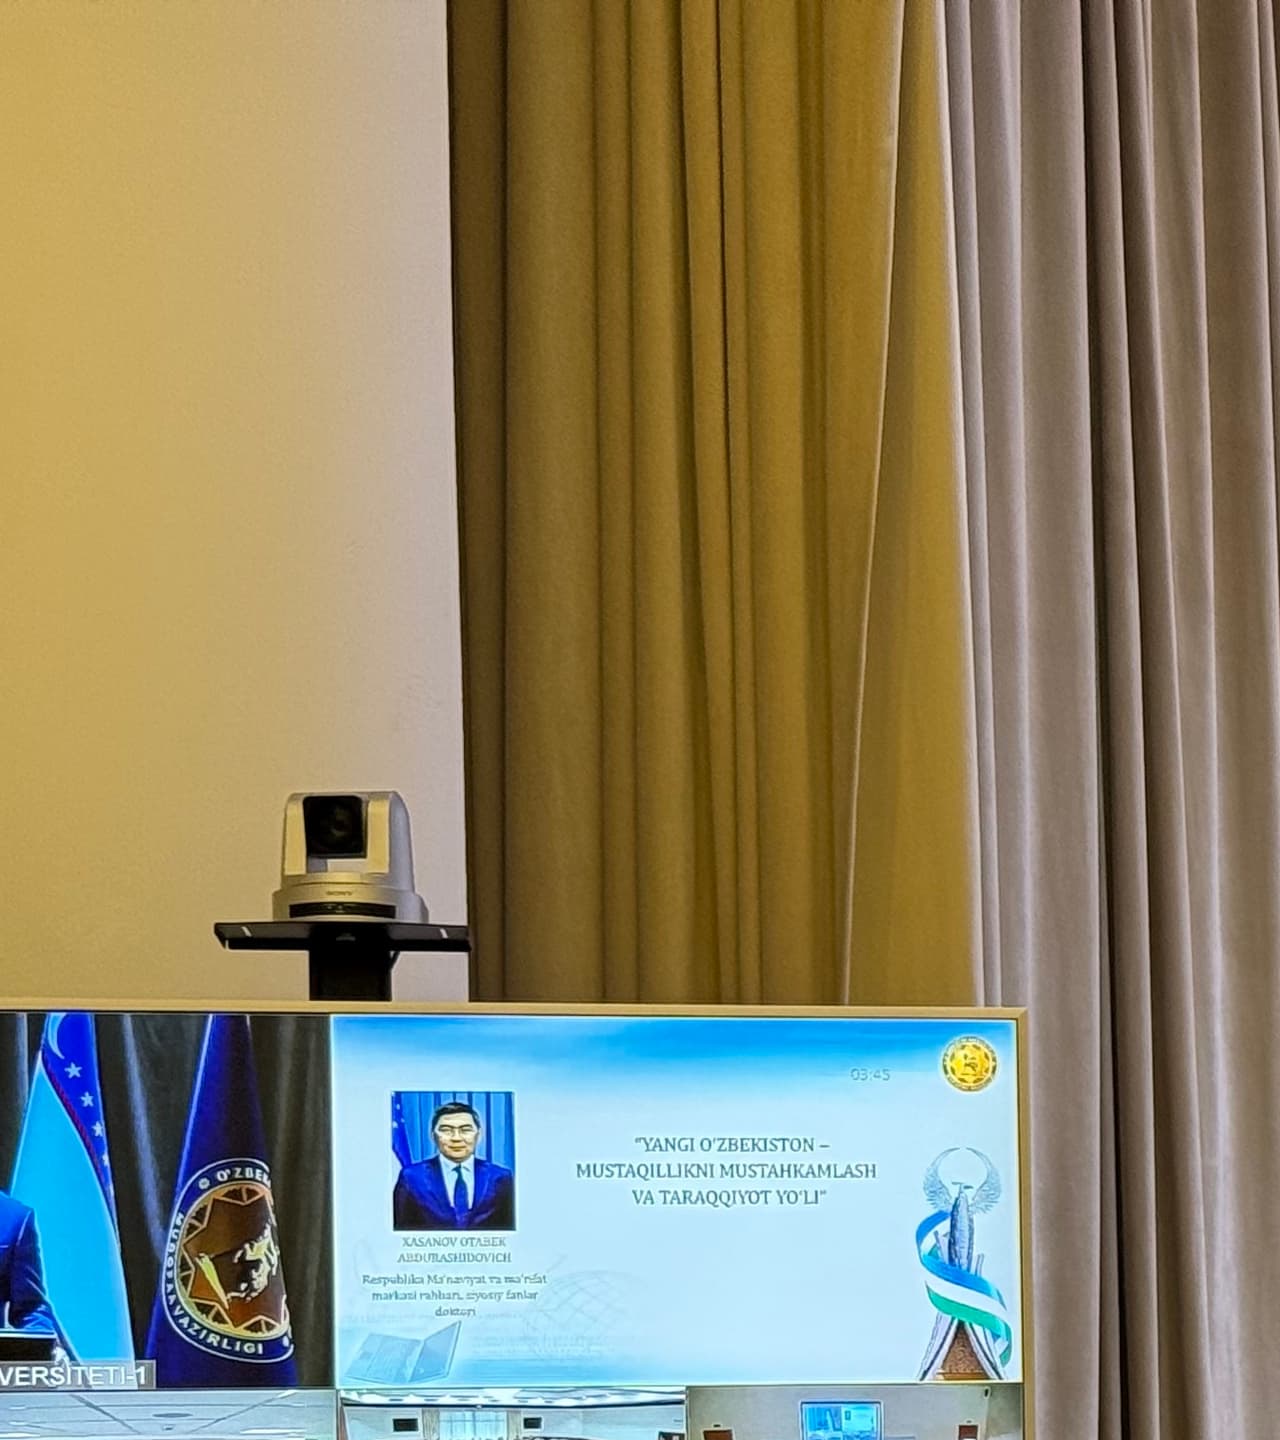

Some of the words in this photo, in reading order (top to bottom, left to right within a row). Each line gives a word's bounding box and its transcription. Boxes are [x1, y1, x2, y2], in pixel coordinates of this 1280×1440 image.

[851, 1068, 890, 1081] 03:45
[576, 1163, 715, 1181] MUSTAQILLIKNI
[720, 1163, 877, 1178] MUSTAHKAMLASH
[632, 1190, 654, 1205] VA
[659, 1190, 771, 1207] TARAQQIYOT
[402, 1236, 457, 1247] XASANOV
[460, 1236, 507, 1247] OTABEK
[397, 1252, 512, 1263] ABDURASHIDOVICH
[362, 1274, 425, 1287] Respublika
[372, 1291, 417, 1301] markazi
[506, 1290, 538, 1300] fanlar
[435, 1306, 476, 1317] doktori
